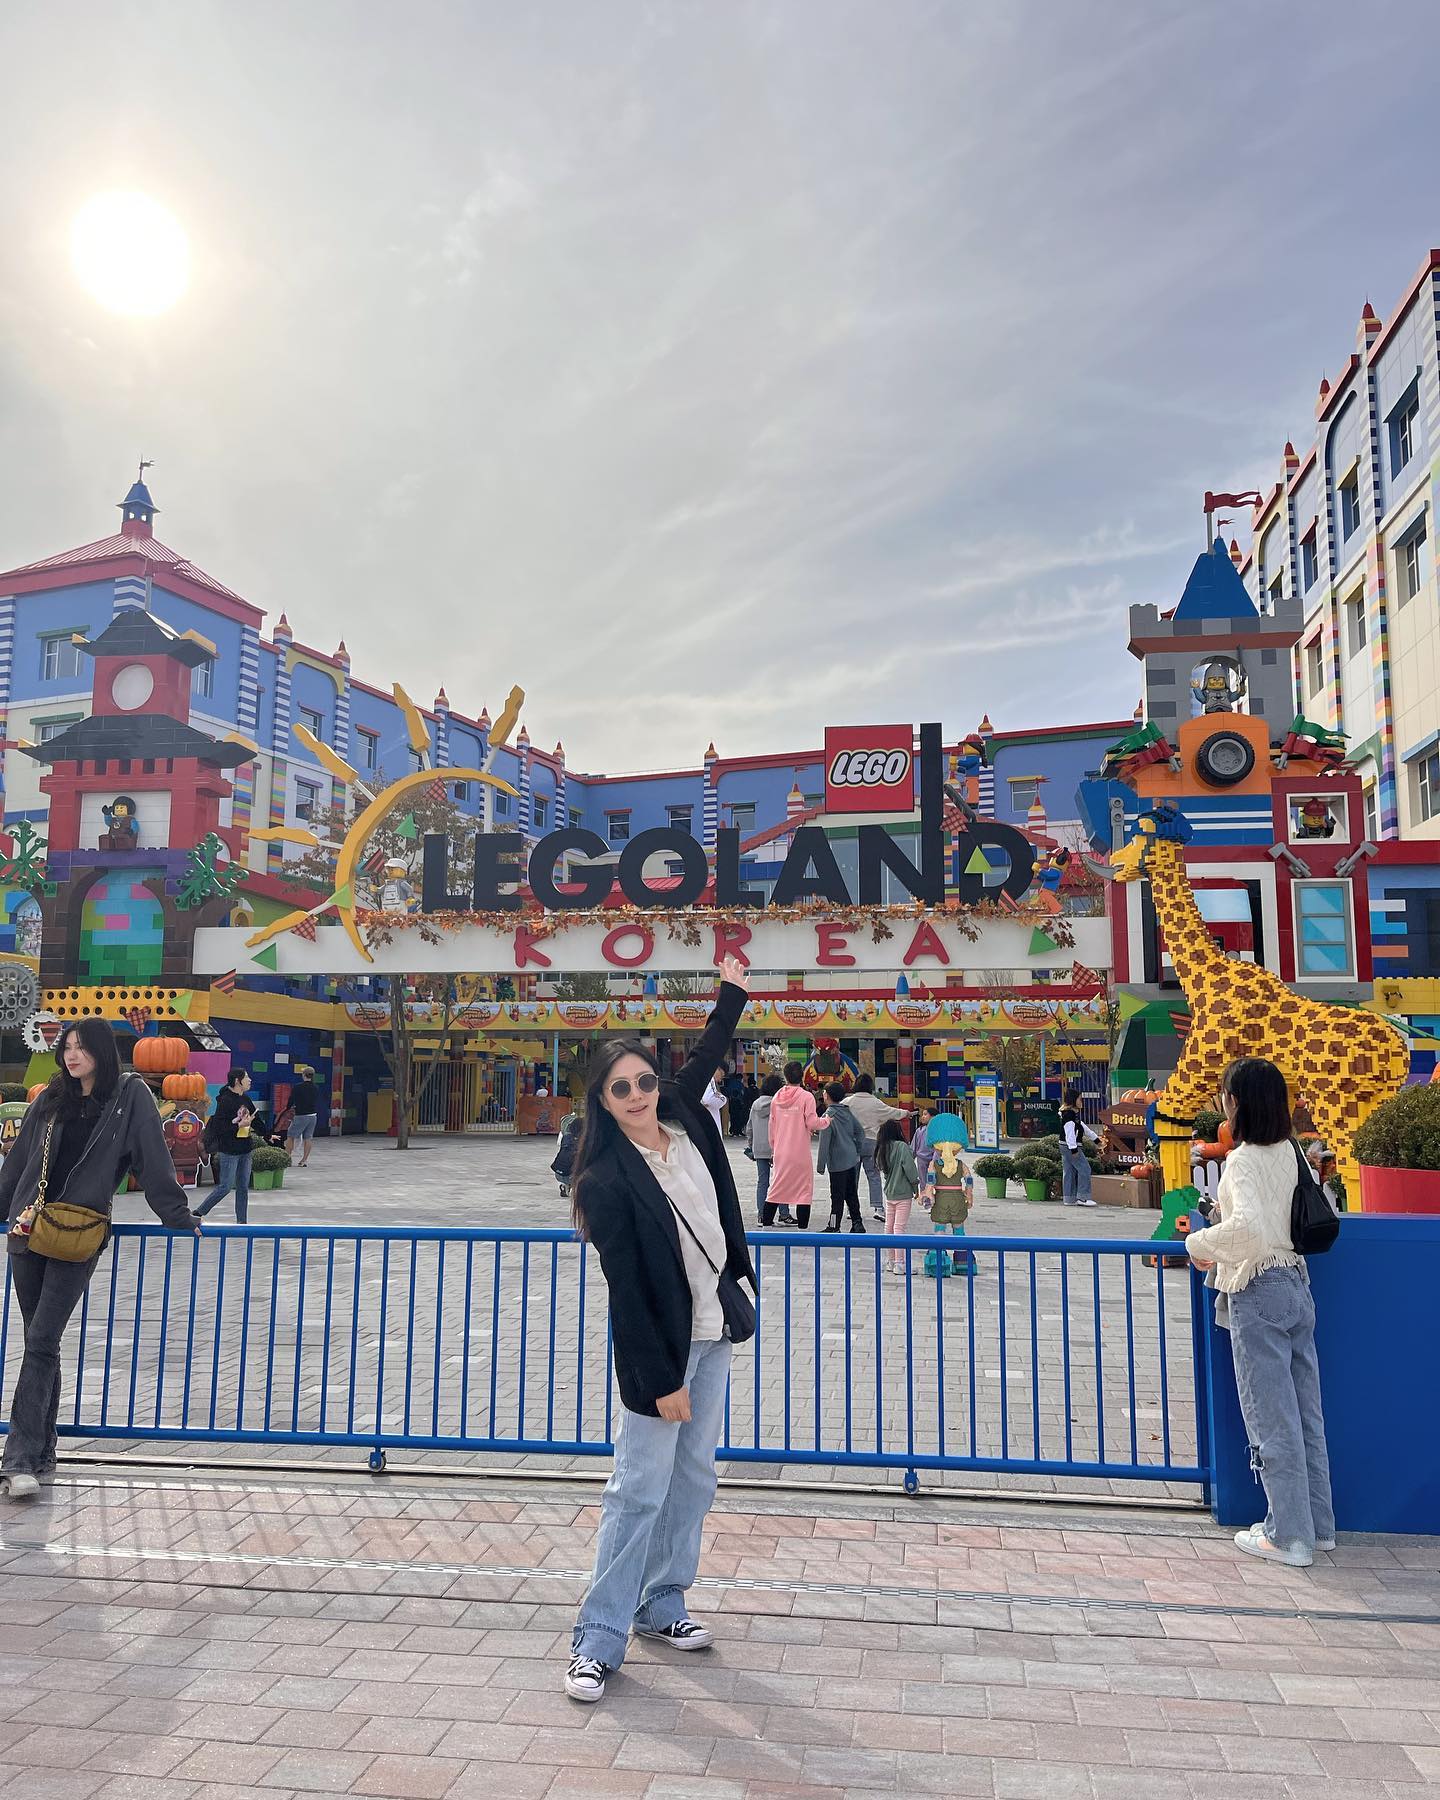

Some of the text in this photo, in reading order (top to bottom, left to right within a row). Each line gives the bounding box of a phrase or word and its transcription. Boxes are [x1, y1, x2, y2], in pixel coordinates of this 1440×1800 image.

[831, 750, 908, 785] LEGO
[422, 723, 1034, 913] LEGOLAND
[514, 921, 950, 967] KOREA
[1118, 1155, 1147, 1164] LEGOL
